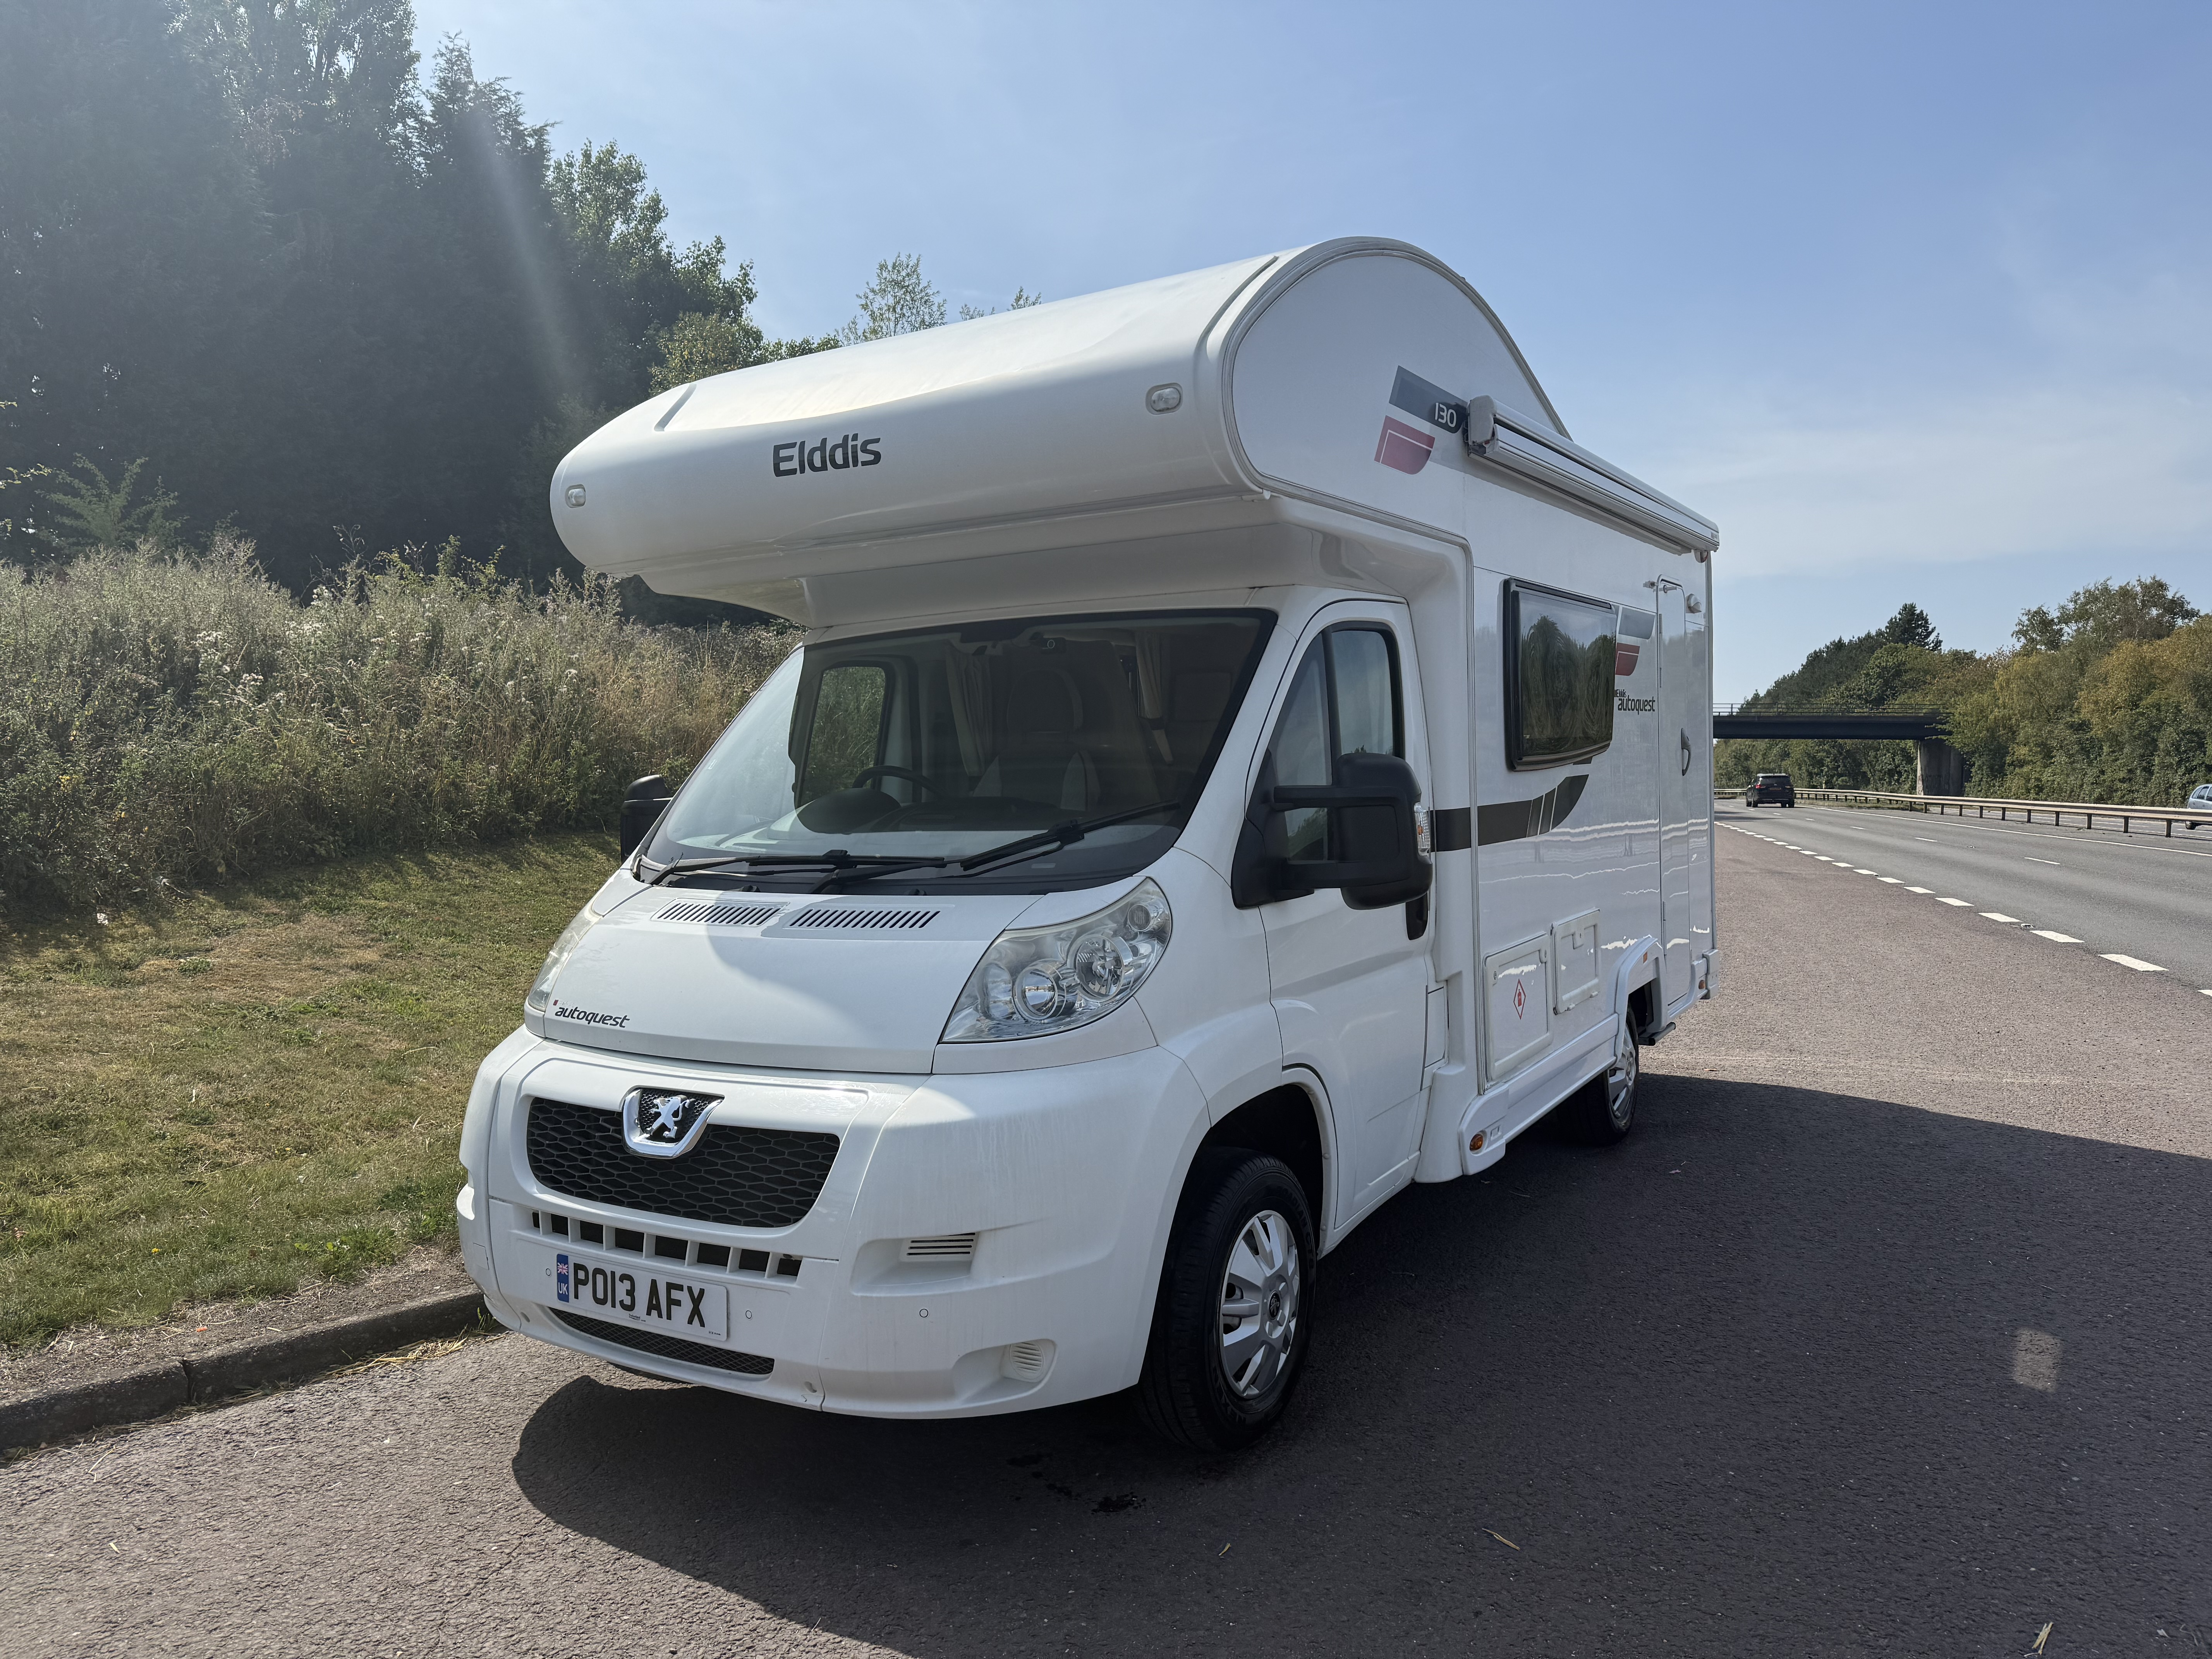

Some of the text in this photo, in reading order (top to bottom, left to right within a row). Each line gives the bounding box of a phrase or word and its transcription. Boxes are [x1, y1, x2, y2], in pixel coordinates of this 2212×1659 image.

[1435, 402, 1456, 427] 130
[773, 433, 881, 477] Elddis
[1618, 695, 1655, 715] autoquest
[555, 1006, 630, 1028] autoquest
[558, 1282, 568, 1295] UK
[573, 1262, 705, 1328] PO13 AFX
